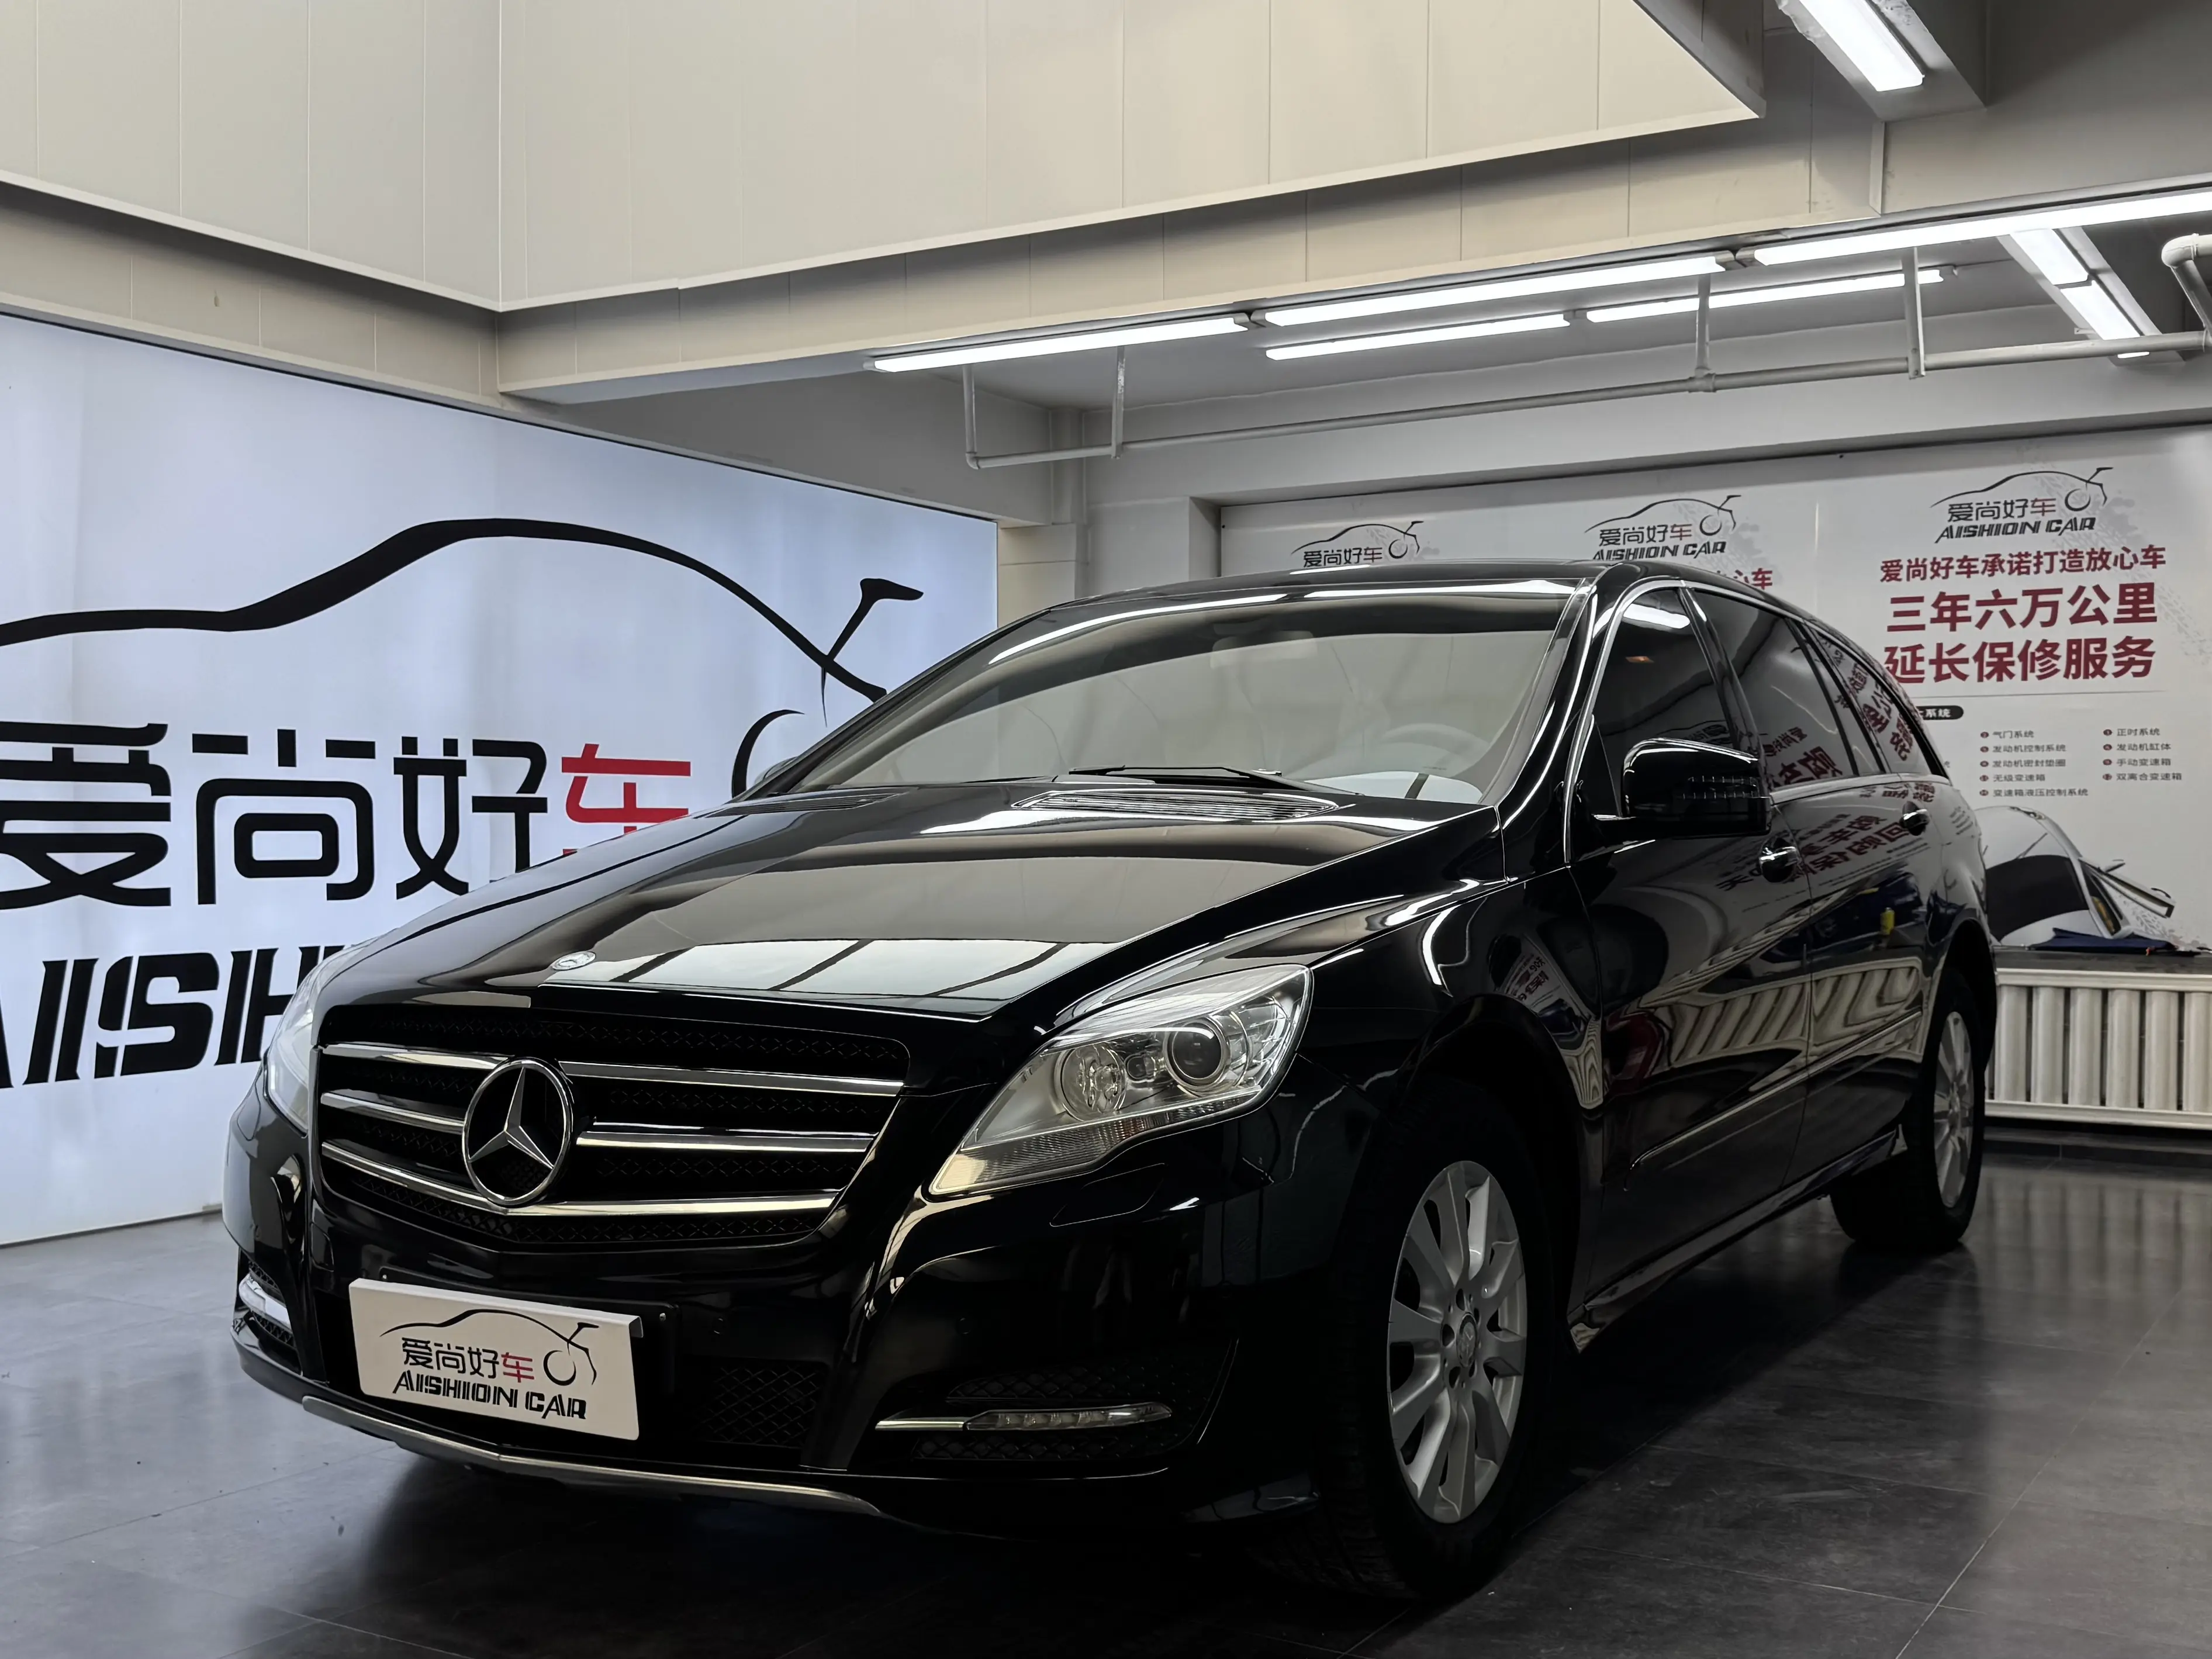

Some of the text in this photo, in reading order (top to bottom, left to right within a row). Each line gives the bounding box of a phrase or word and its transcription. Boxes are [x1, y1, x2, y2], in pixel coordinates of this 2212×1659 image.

[1948, 498, 2056, 522] 爱尚好车
[1599, 524, 1692, 546] 爱尚好车
[1934, 517, 2096, 544] AISHION CAR
[1304, 547, 1383, 568] 爱尚好车
[1683, 541, 1727, 559] CAR
[1880, 545, 2166, 583] 爱尚好车承诺打造放心车
[1886, 582, 2158, 633] 三年六万公里
[1883, 636, 2156, 683] 延长保修服务
[1993, 730, 2034, 739] 气门系统
[2117, 728, 2161, 737] 正时系统
[1992, 744, 2066, 753] 发动机控制系统
[2116, 743, 2172, 752] 发动机缸体
[2116, 758, 2172, 767] 手动变速箱
[402, 1337, 535, 1383] 爱尚好车
[392, 1370, 587, 1419] AISHION CAR
